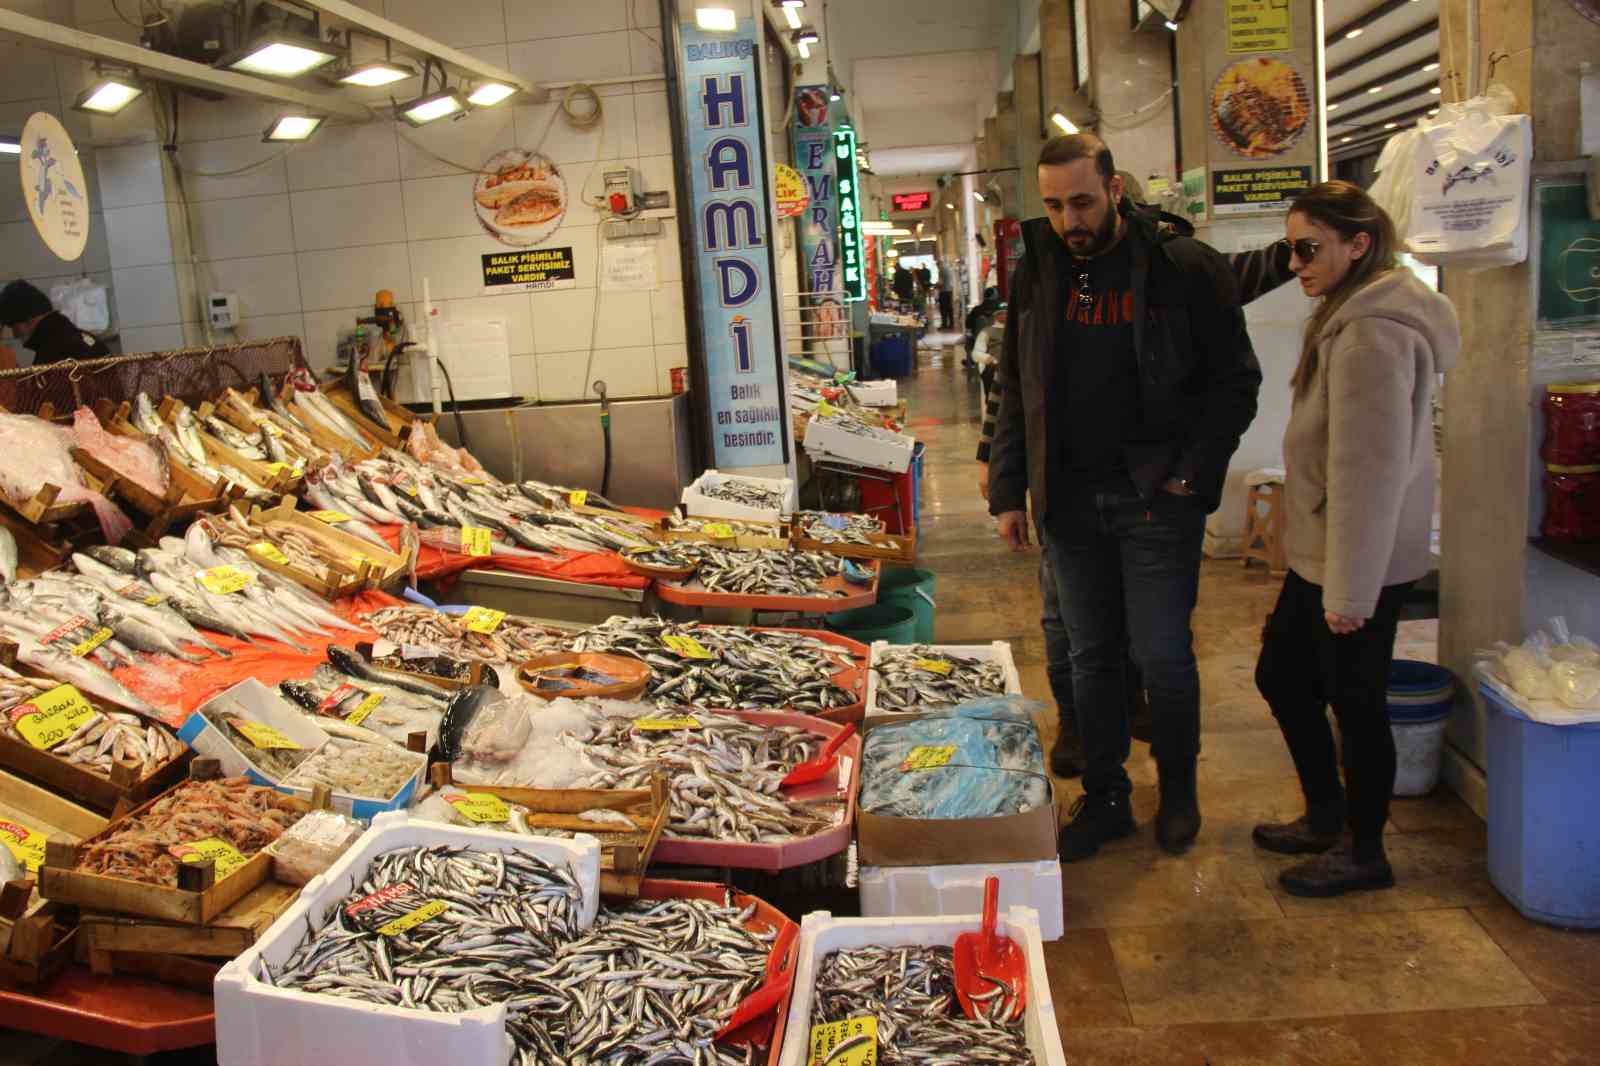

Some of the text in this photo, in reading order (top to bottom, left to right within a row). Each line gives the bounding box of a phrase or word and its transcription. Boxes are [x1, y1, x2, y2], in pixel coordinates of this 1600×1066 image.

[702, 74, 764, 371] HAMDİ
[807, 143, 835, 293] EMRAH
[838, 179, 859, 282] SAĞLIK
[491, 251, 563, 265] BALIK PİŞİRİLİR
[486, 260, 570, 276] PAKET SERVİSİMİZ
[511, 273, 545, 283] VARDIR
[731, 384, 761, 401] Balık
[717, 411, 732, 425] en
